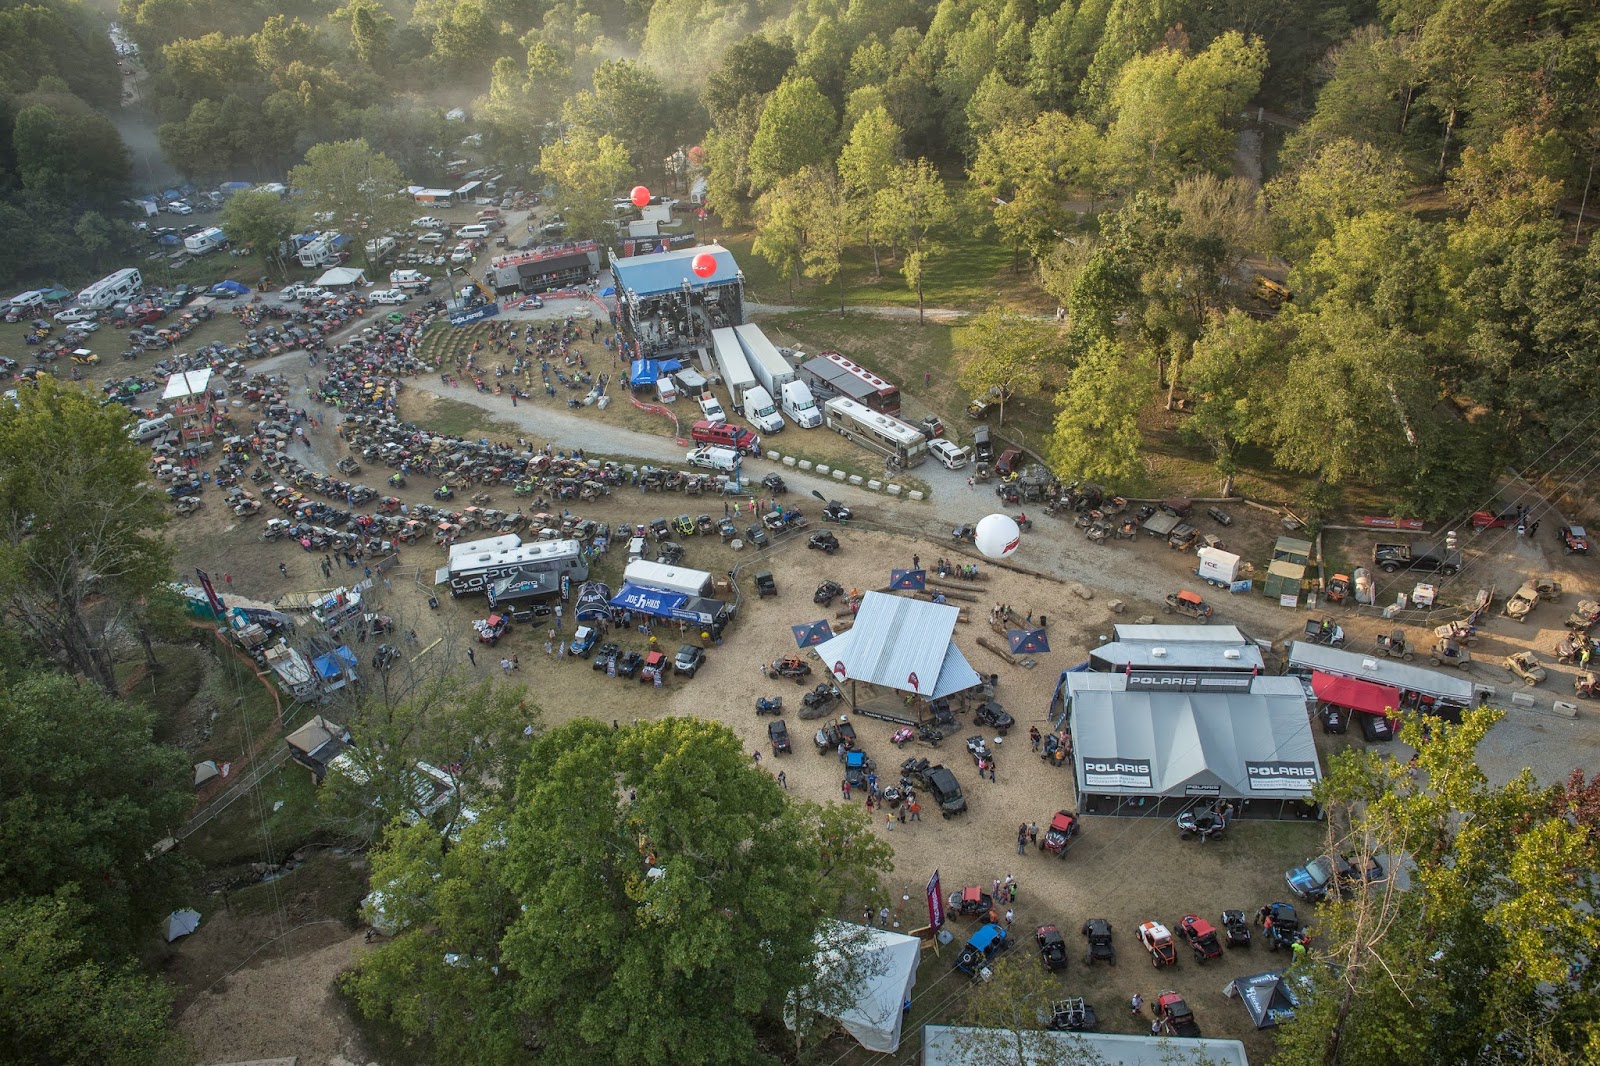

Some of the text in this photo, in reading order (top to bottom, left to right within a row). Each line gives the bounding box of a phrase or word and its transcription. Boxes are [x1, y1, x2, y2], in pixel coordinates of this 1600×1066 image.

[452, 310, 484, 324] POLARIS
[508, 580, 538, 589] GoPro
[625, 594, 638, 604] JOE
[1130, 677, 1197, 686] POLARIS
[1085, 763, 1149, 773] POLARIS
[1248, 767, 1315, 776] POLARIS
